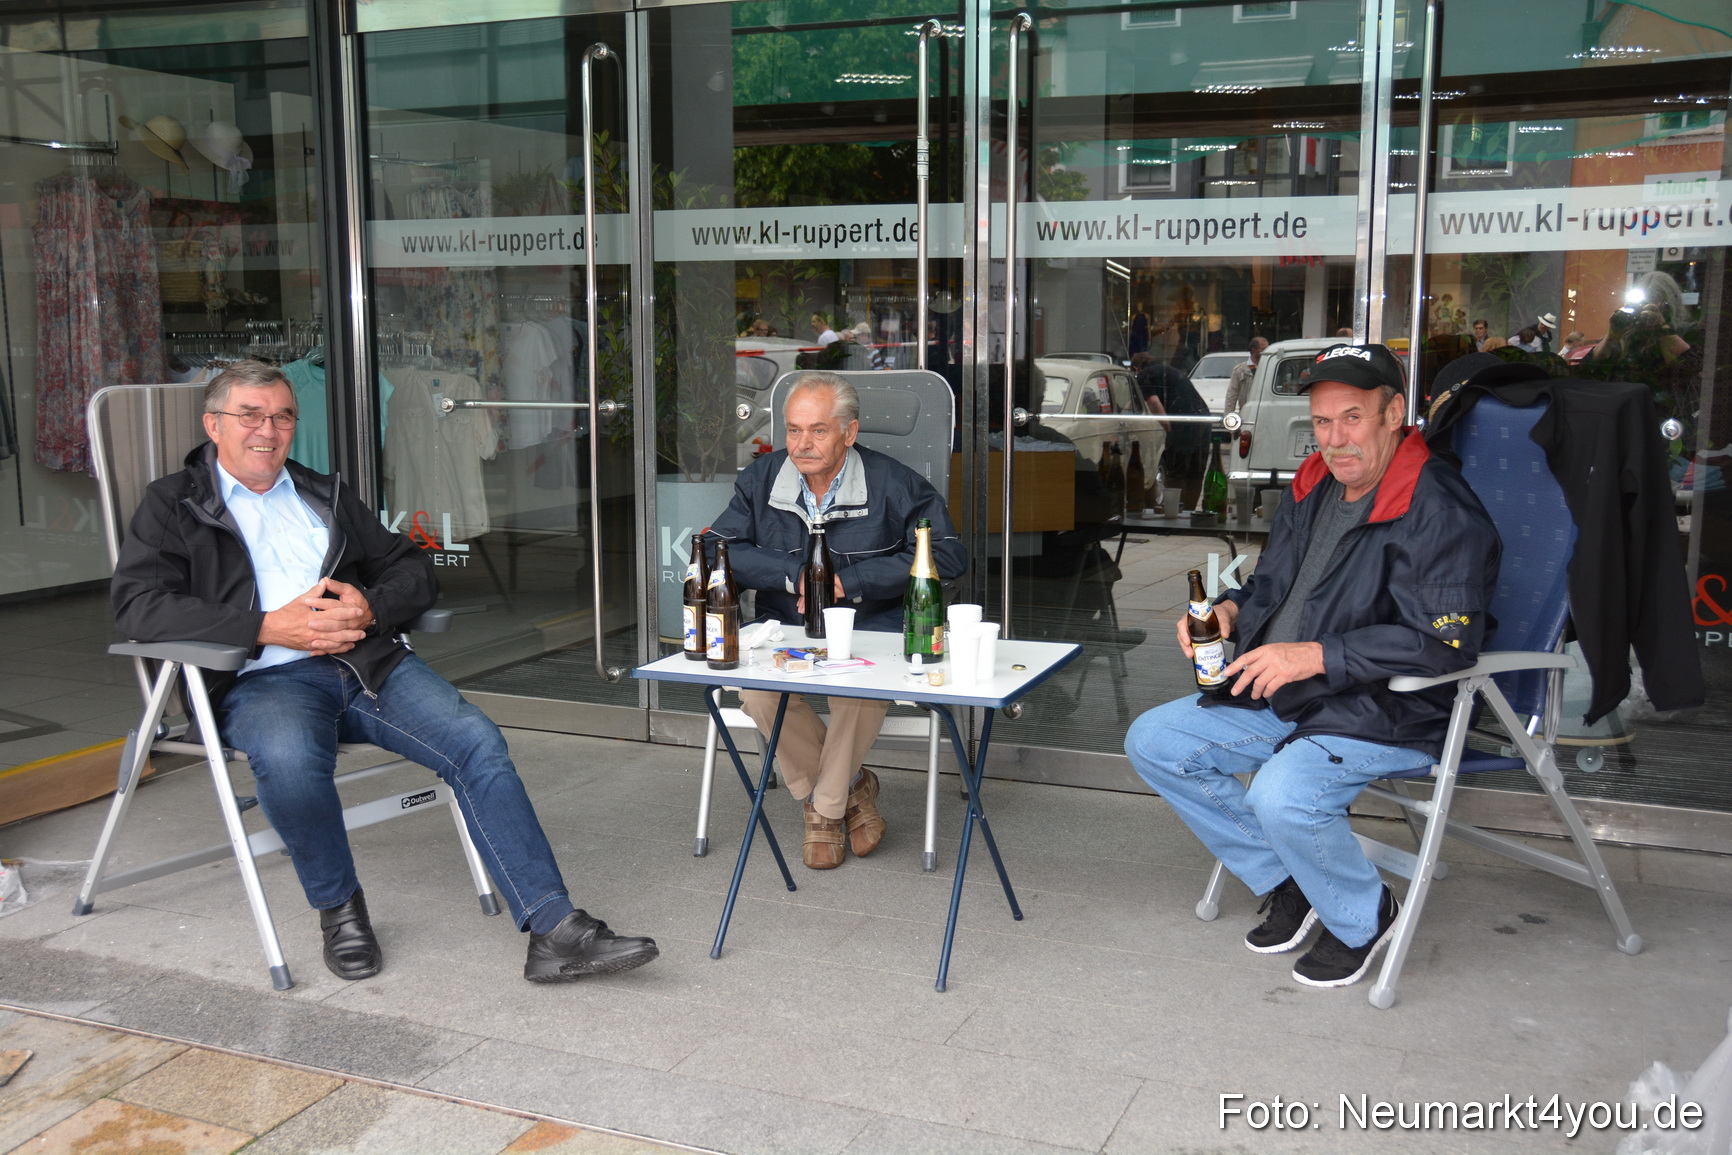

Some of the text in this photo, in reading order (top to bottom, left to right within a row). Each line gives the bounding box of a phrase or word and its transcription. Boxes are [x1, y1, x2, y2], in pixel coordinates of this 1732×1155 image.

[1036, 211, 1308, 245] www.kl-ruppert.de
[402, 227, 598, 256] www.kl-ruppert.d
[1322, 347, 1371, 361] LEGEA
[428, 553, 470, 567] ERT
